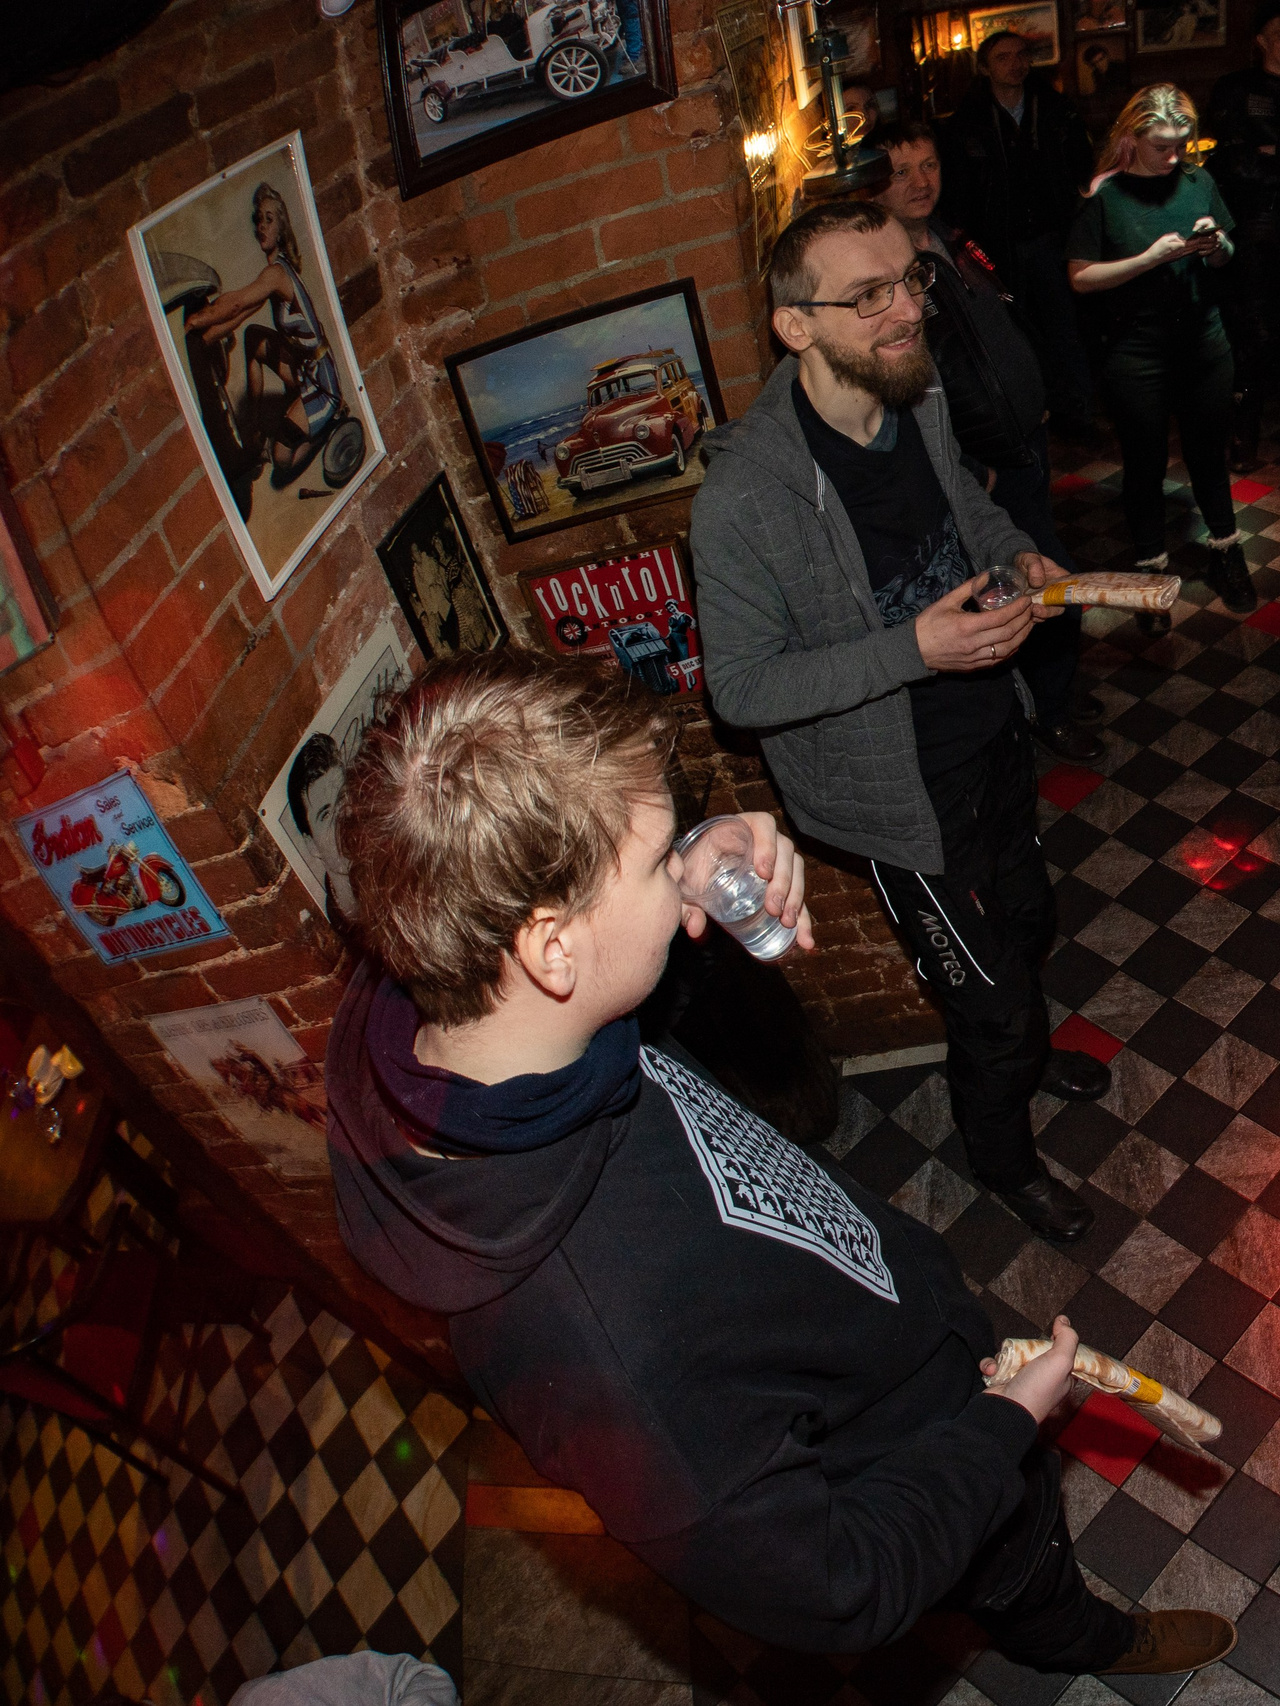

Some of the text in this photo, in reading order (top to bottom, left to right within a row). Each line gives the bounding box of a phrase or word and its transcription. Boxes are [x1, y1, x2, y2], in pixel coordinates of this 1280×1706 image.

[587, 551, 651, 571] BRITISH
[584, 608, 665, 633] ANTHOLOGY
[669, 665, 679, 677] 5
[96, 794, 121, 814] Sales
[120, 815, 155, 836] Service
[32, 814, 103, 867] Indian
[98, 905, 212, 955] MOTORCYCLES
[917, 909, 967, 986] MOTEQ
